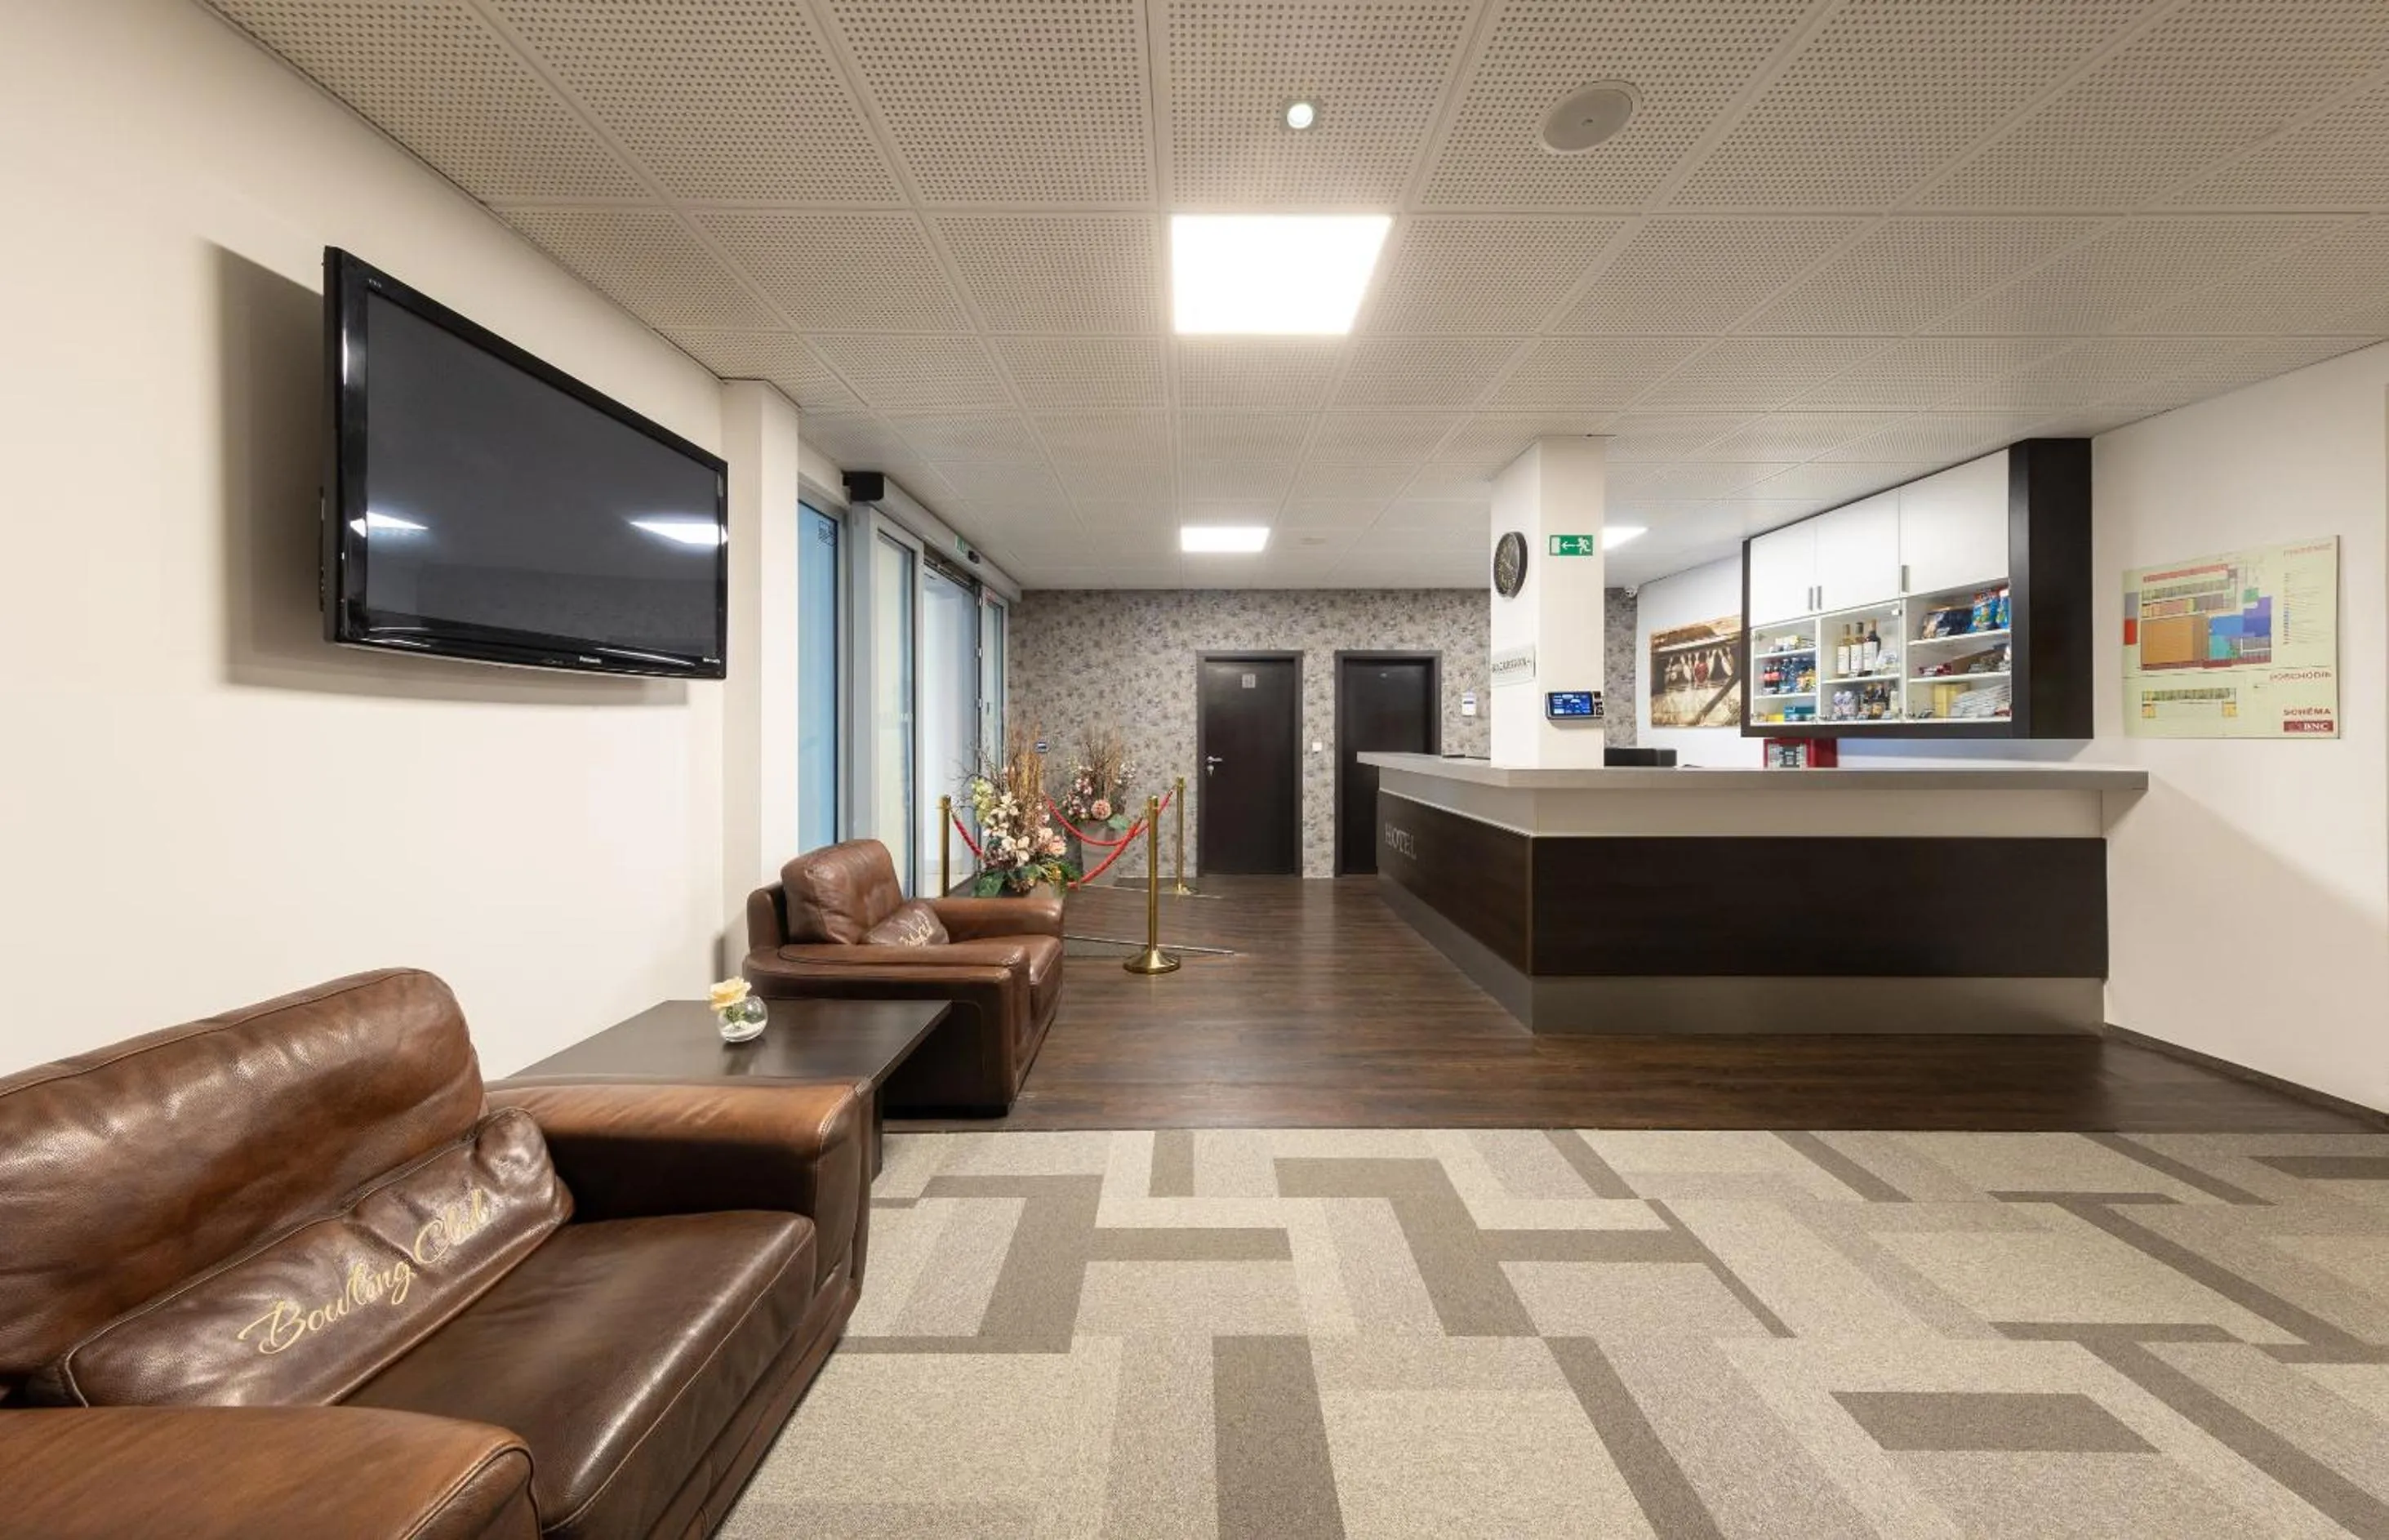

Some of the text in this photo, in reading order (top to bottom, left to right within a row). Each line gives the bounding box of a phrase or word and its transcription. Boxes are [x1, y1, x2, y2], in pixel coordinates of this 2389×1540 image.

[1385, 822, 1417, 860] HOTEL
[238, 1189, 490, 1355] Bowling Club
